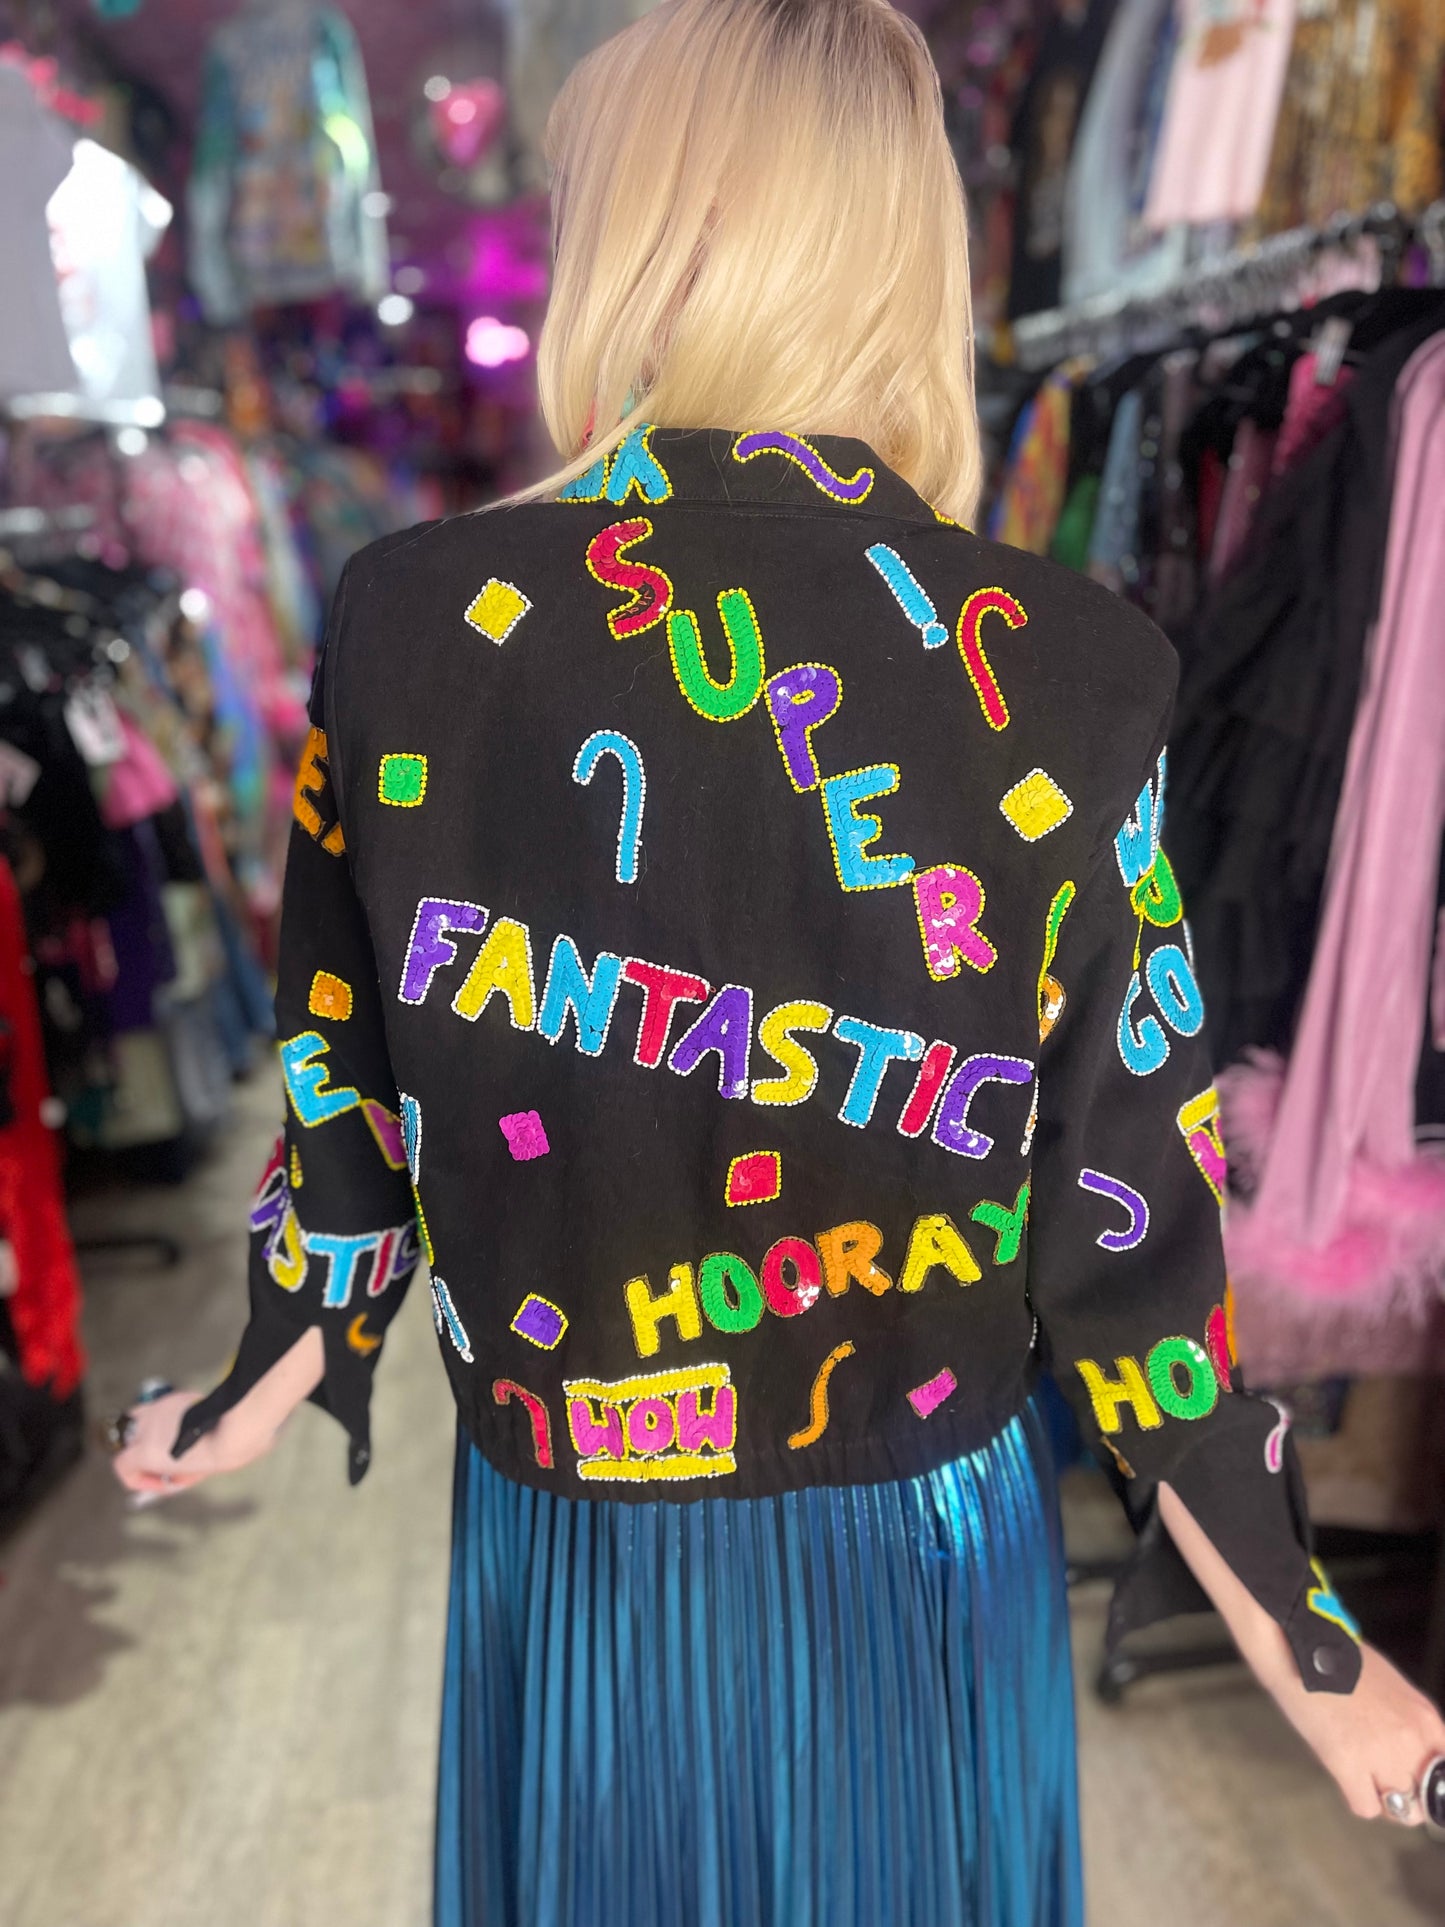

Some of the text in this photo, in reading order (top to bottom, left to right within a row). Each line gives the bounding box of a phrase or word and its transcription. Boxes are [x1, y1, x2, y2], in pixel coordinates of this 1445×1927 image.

[586, 516, 999, 982] SUPER
[398, 896, 1034, 1159] FANTASTIC
[624, 1180, 1033, 1358] HOORAY
[565, 1383, 738, 1460] WOW
